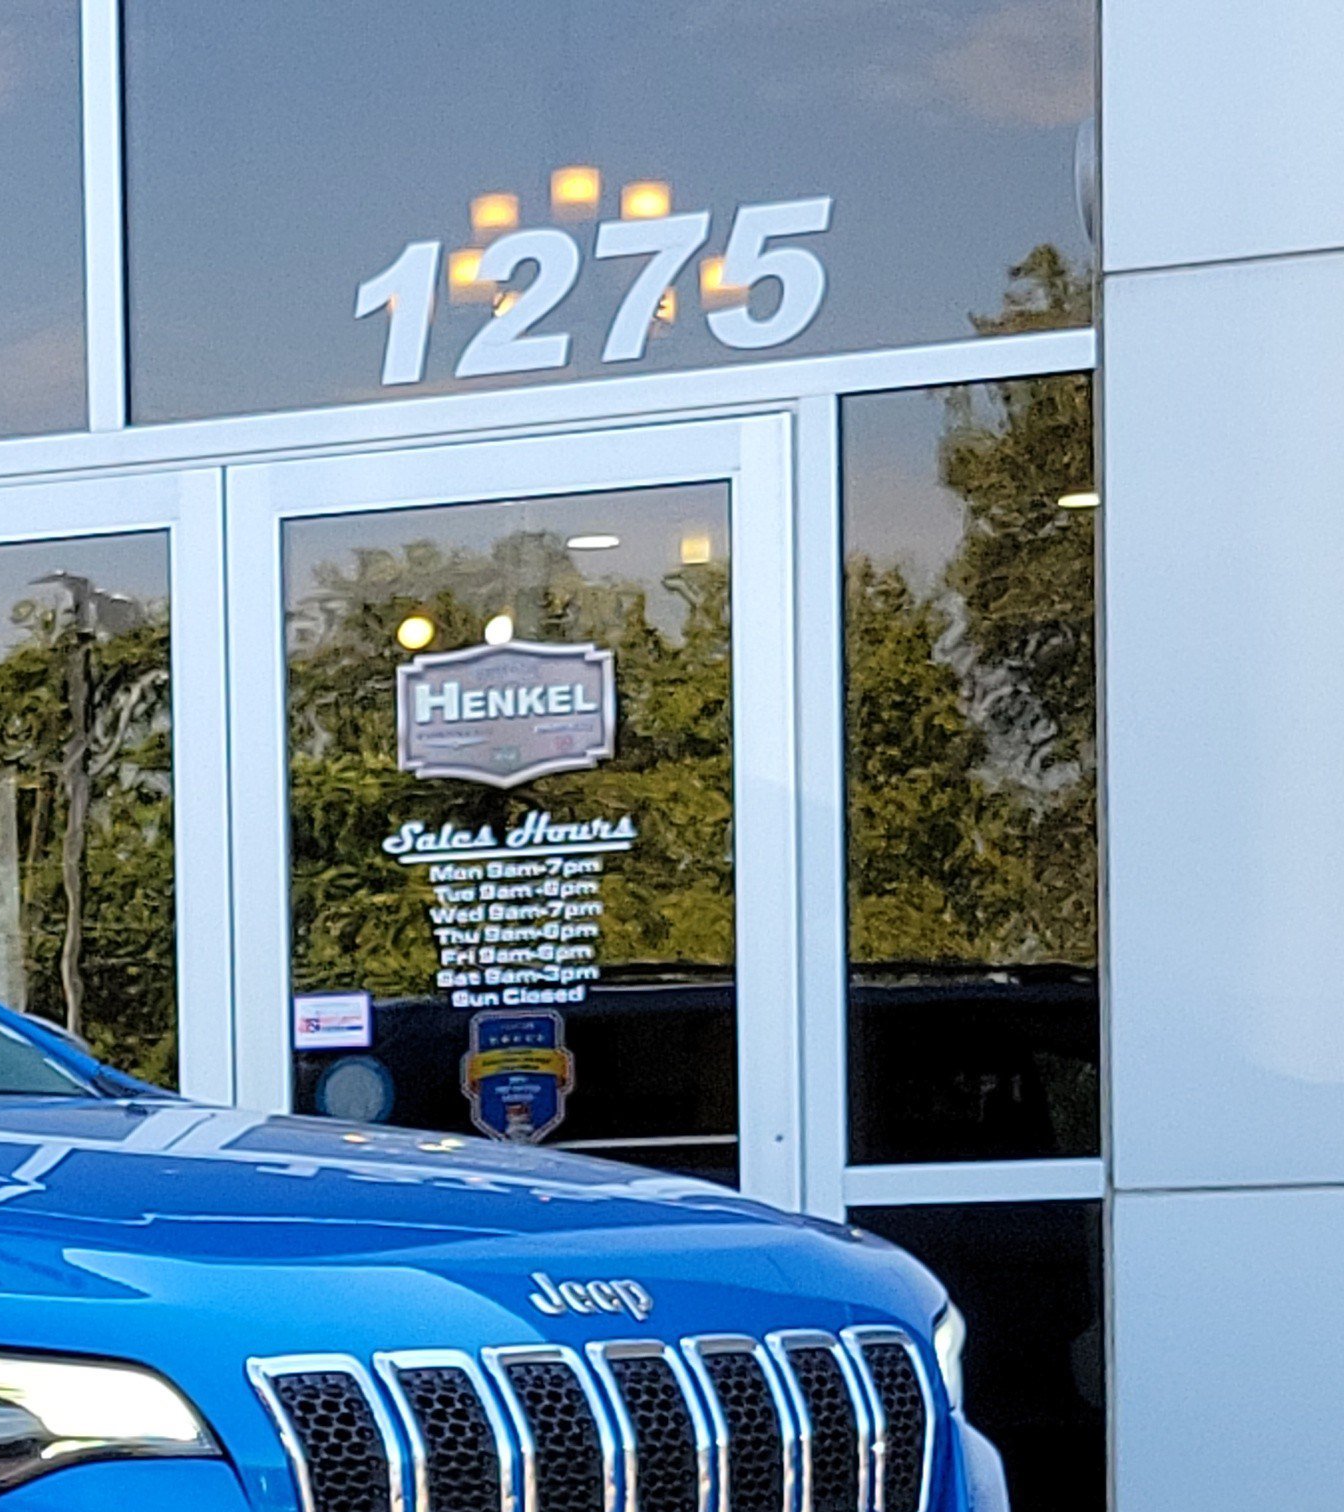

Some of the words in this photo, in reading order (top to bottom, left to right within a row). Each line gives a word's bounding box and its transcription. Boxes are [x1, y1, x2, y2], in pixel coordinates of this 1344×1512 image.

[354, 196, 833, 386] 1275
[414, 680, 599, 724] HENKEL
[382, 820, 498, 854] Sales
[506, 810, 638, 848] Hours
[429, 865, 483, 882] Mon
[433, 885, 475, 902] Tue
[429, 906, 484, 924] Wed
[434, 927, 480, 944] Thu
[441, 949, 475, 966] Fri
[437, 970, 481, 987] Sat
[451, 990, 499, 1007] Sun
[503, 985, 586, 1005] Closed
[529, 1272, 653, 1321] Jeep
